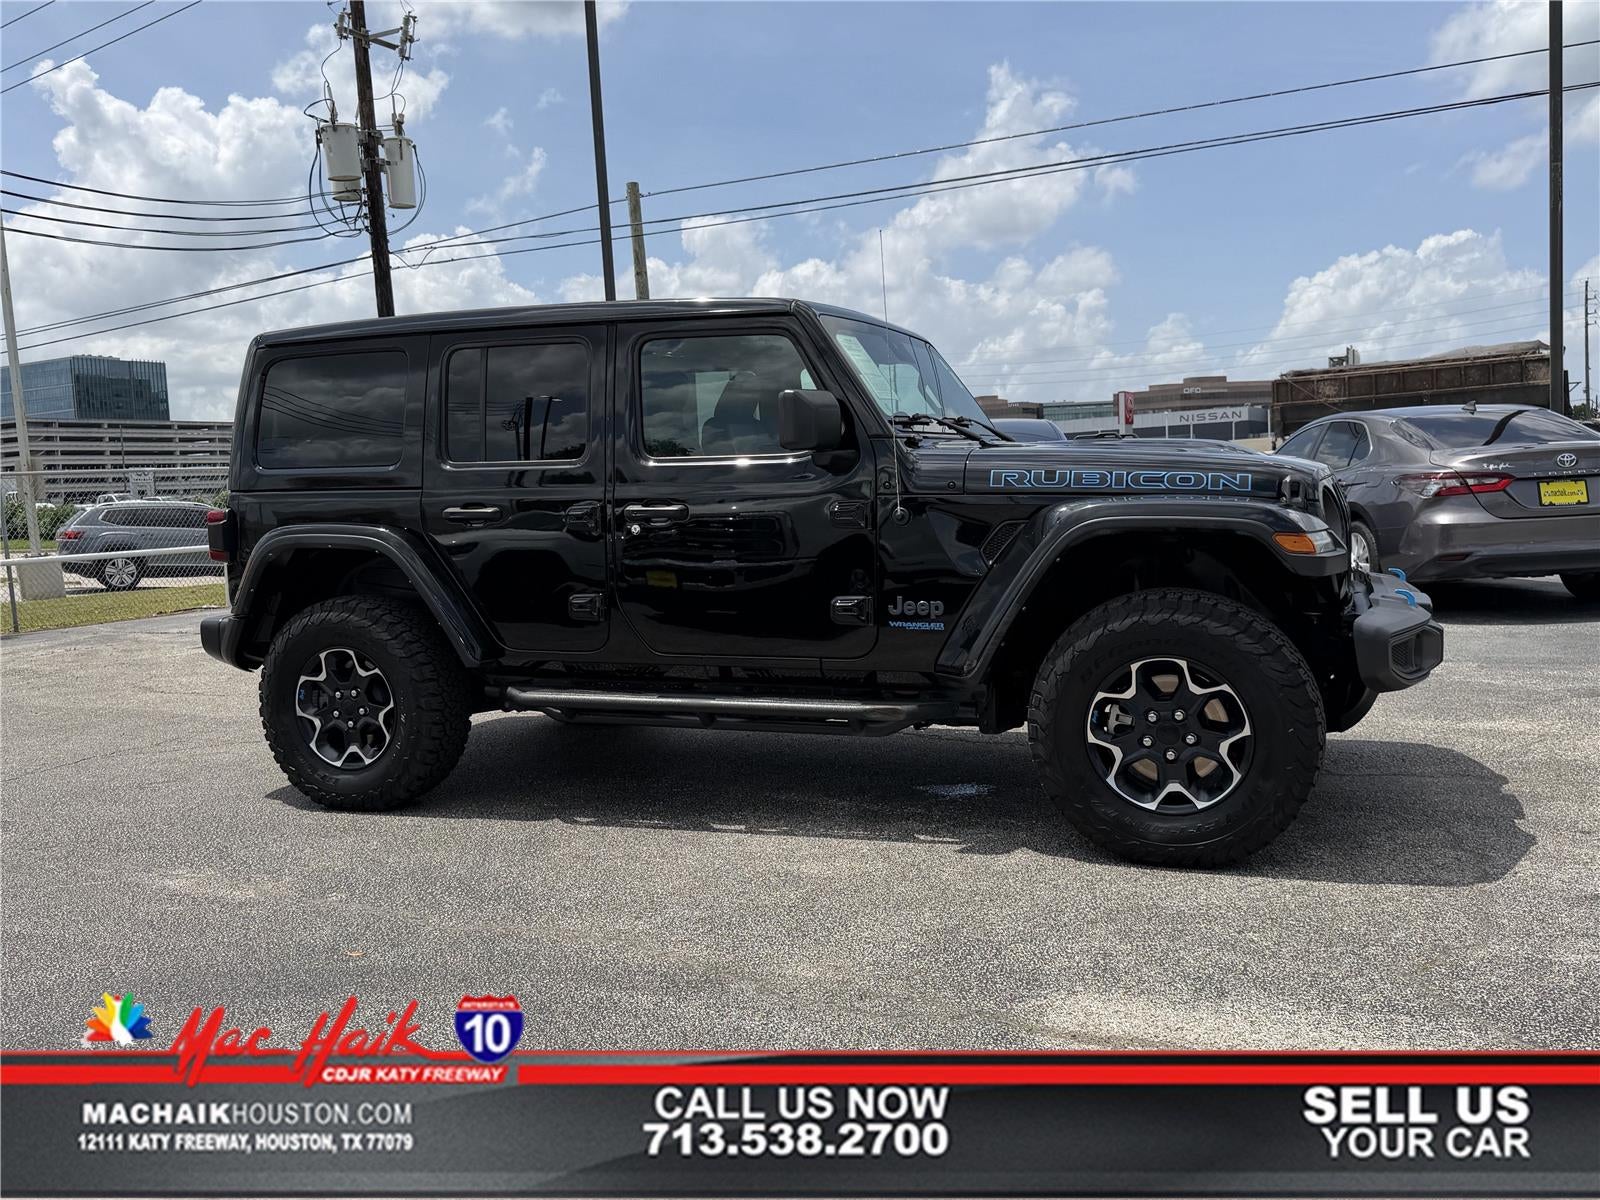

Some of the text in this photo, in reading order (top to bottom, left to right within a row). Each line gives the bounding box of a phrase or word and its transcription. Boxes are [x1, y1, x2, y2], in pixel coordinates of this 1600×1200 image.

[1179, 410, 1242, 423] NISSAN
[990, 469, 1252, 491] RUBICON
[888, 595, 945, 619] Jeep
[888, 620, 945, 628] WRANGLER
